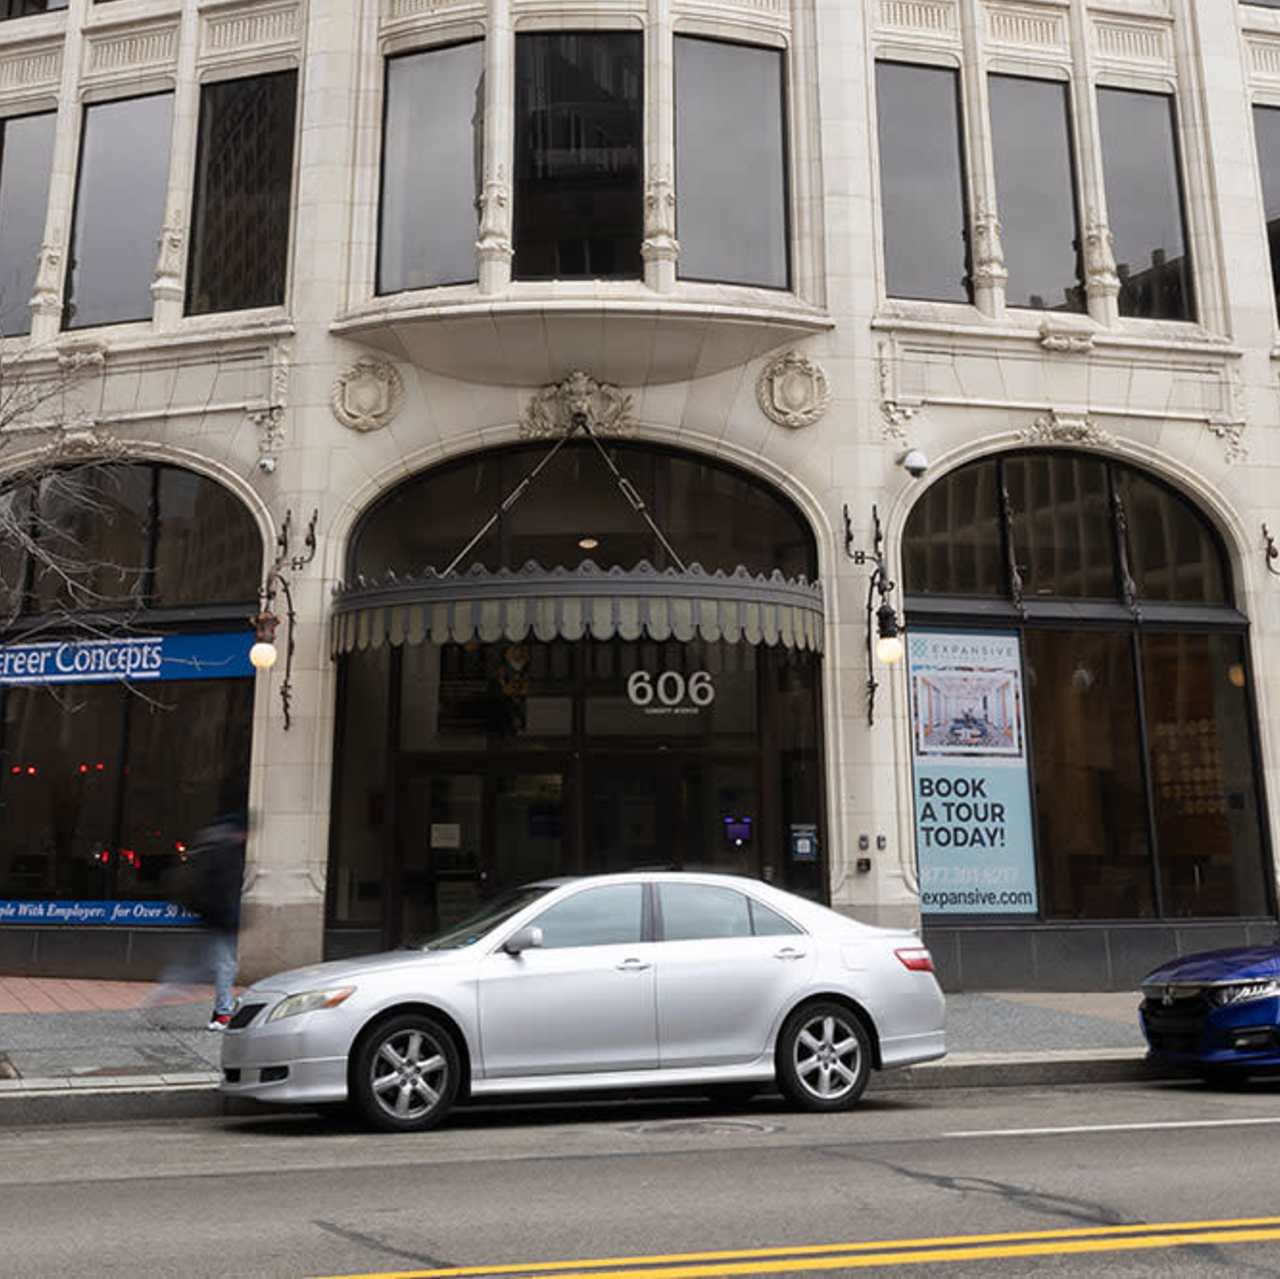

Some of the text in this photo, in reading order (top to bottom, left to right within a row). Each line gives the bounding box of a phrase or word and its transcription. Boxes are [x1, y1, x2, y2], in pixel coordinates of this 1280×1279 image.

[55, 642, 162, 675] Concepts
[931, 644, 1013, 657] EXPANSIVE
[627, 670, 715, 706] 606
[919, 777, 987, 798] BOOK
[920, 801, 1005, 822] A TOUR
[920, 826, 1005, 847] TODAY!
[921, 887, 1033, 908] expansive.com
[18, 902, 45, 916] With
[110, 903, 131, 920] for
[133, 903, 161, 917] Over
